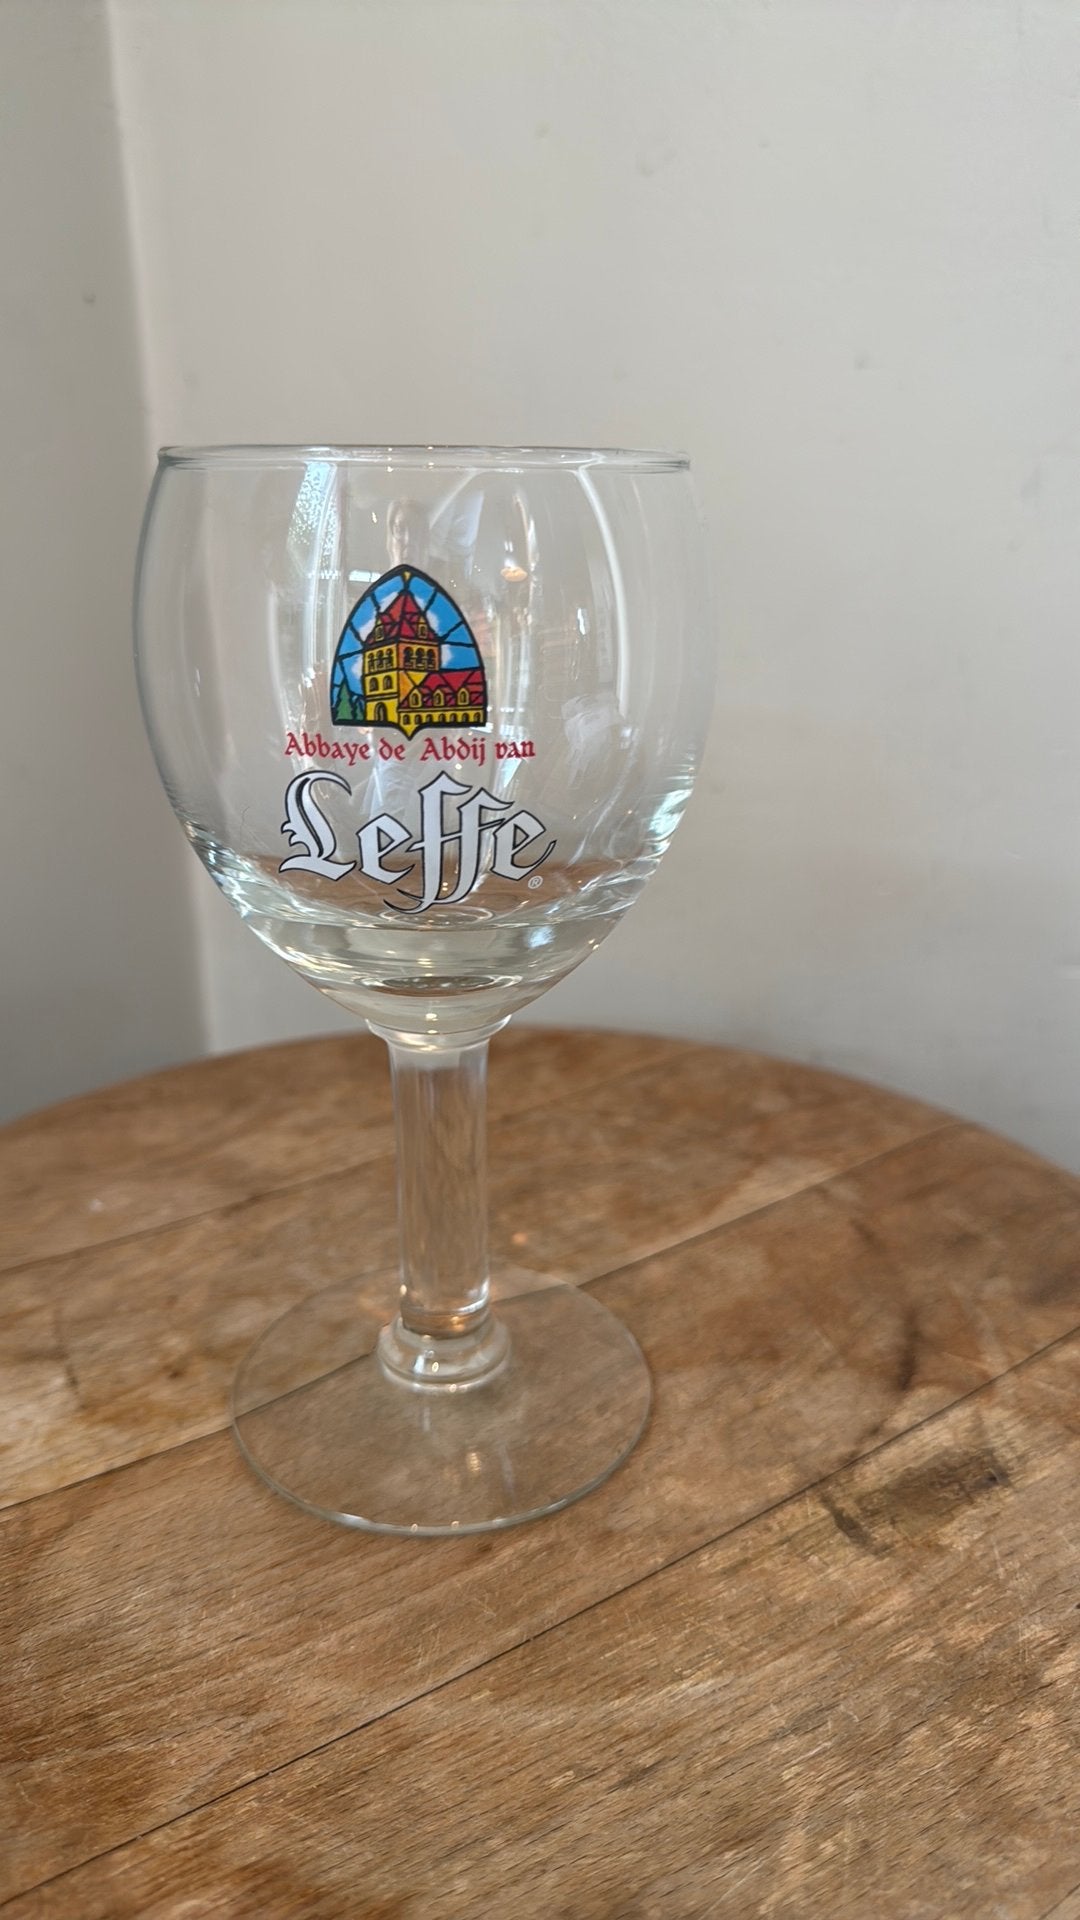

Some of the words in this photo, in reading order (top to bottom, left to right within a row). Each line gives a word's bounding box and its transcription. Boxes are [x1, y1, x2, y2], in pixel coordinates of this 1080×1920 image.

[284, 732, 370, 766] Abbaye
[378, 737, 406, 761] de
[419, 736, 486, 767] Abdij
[495, 740, 536, 760] van
[279, 770, 557, 914] Leffe
